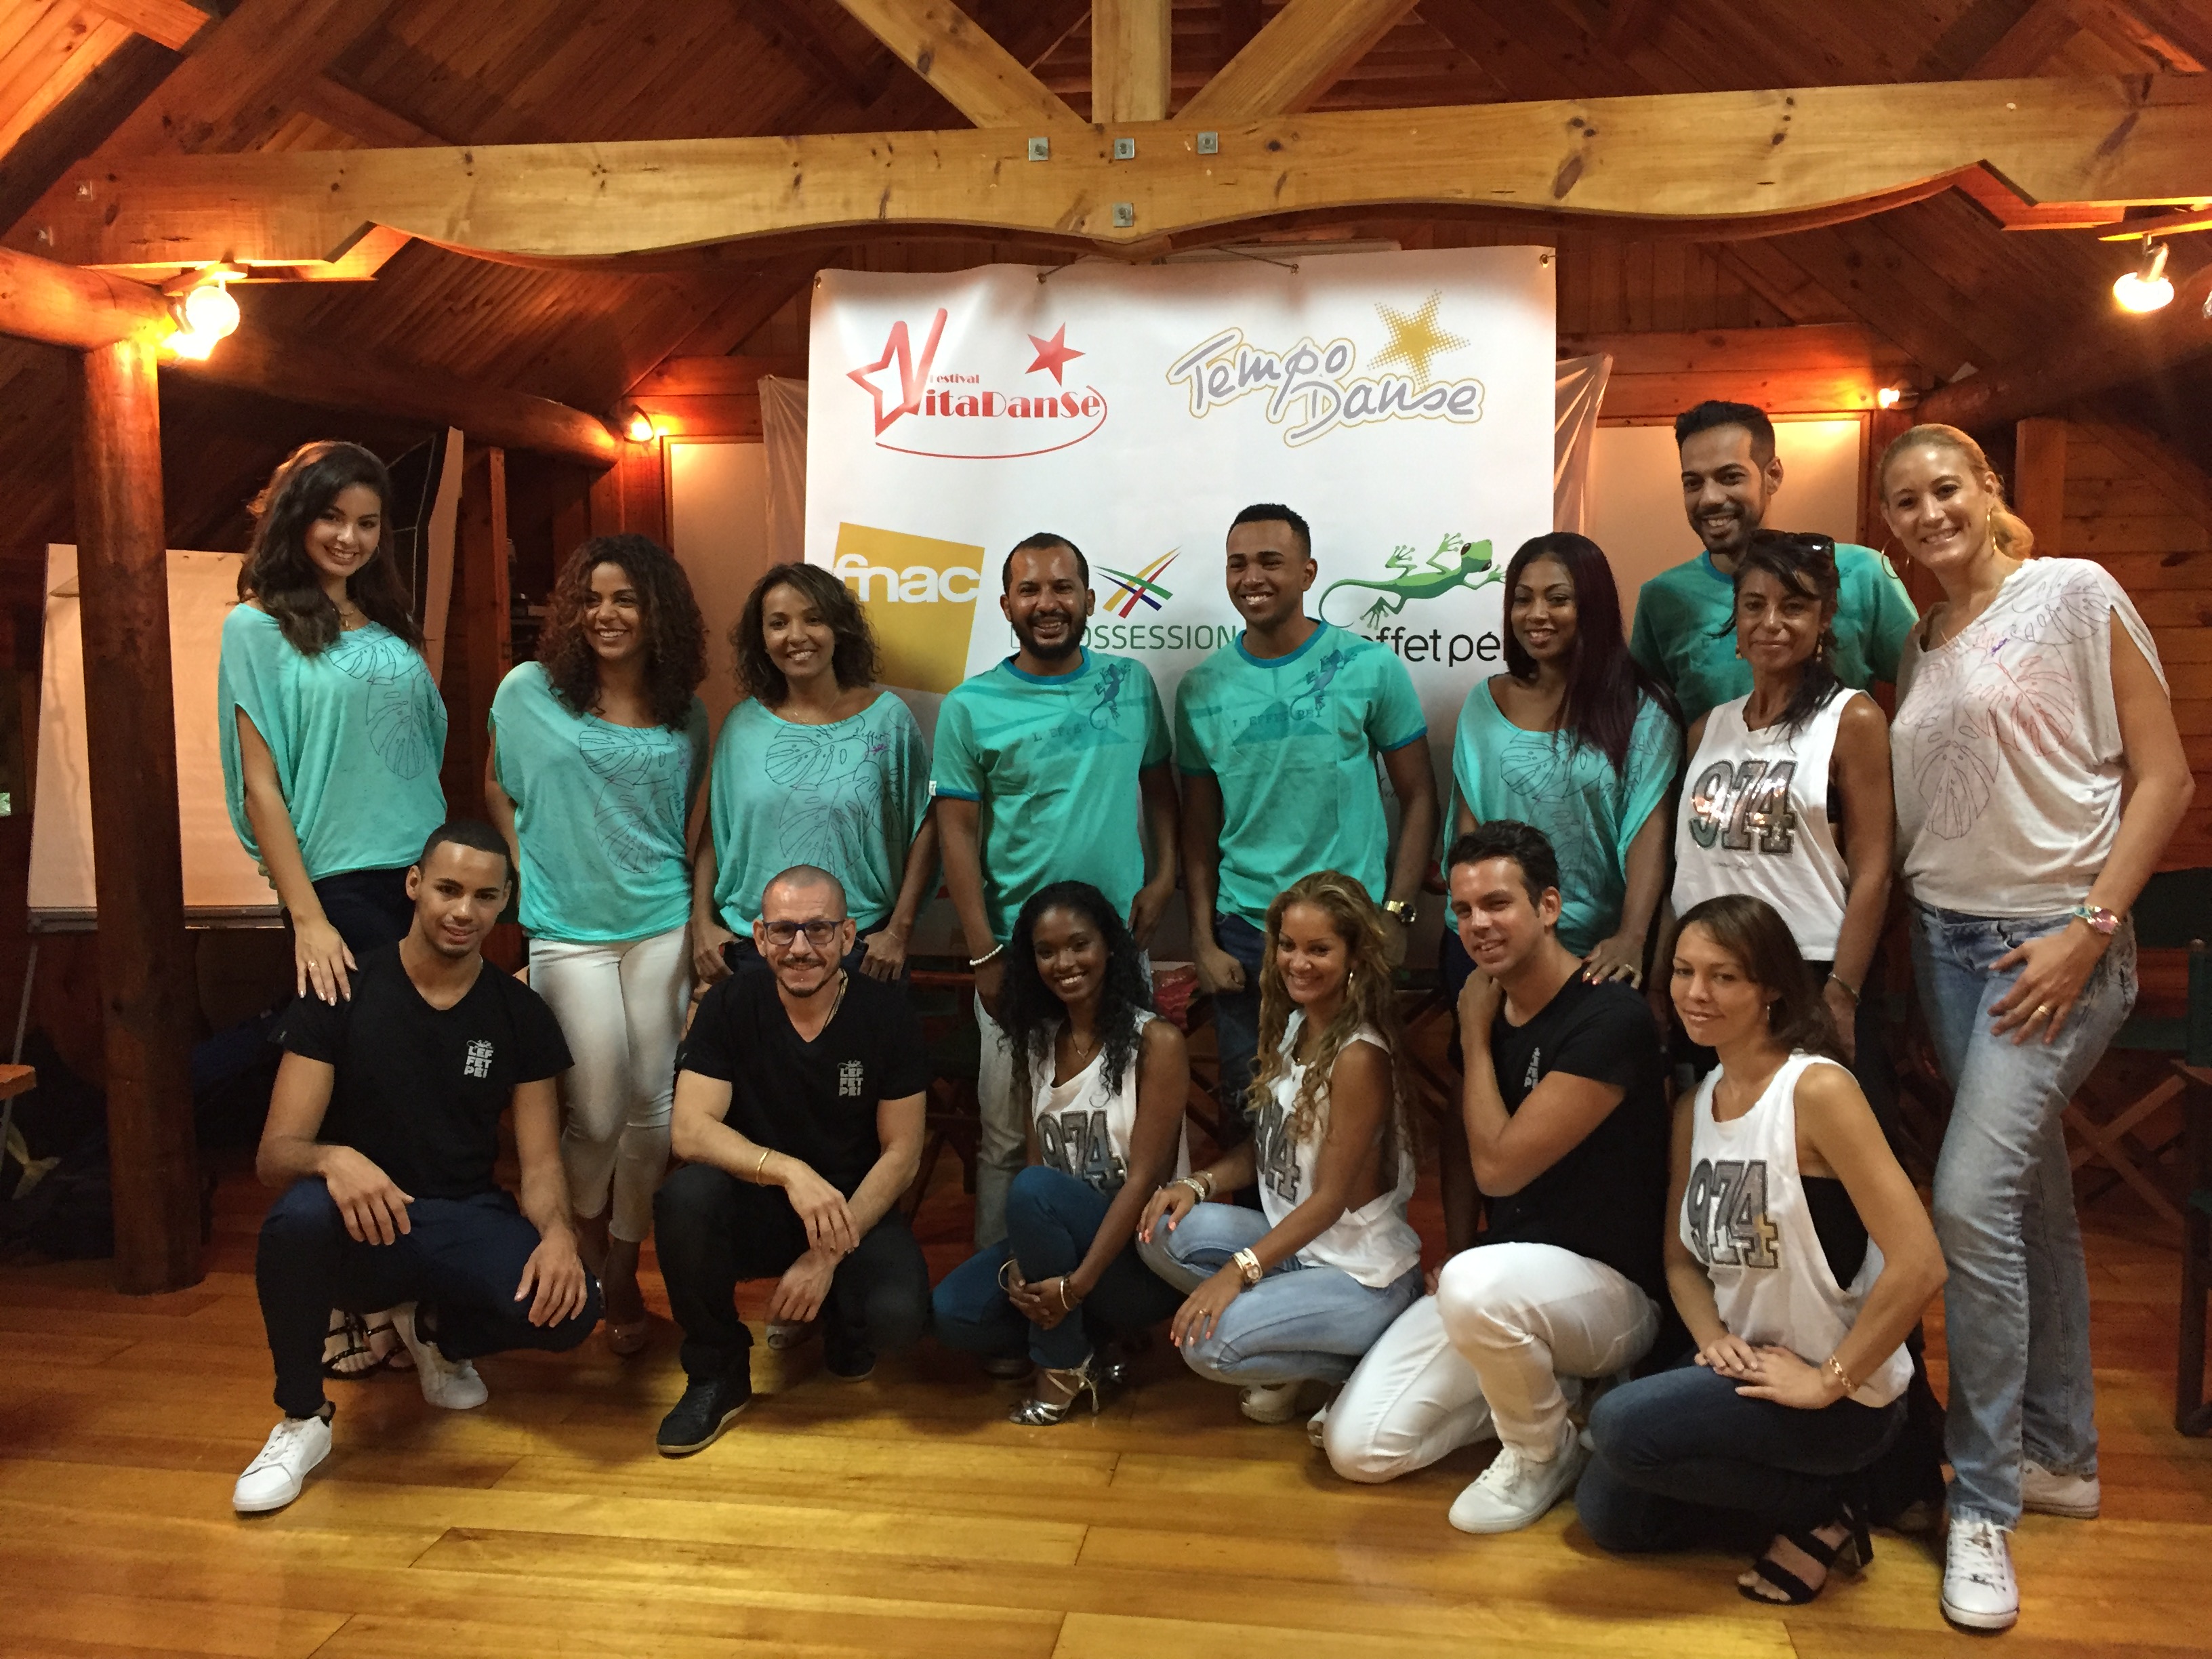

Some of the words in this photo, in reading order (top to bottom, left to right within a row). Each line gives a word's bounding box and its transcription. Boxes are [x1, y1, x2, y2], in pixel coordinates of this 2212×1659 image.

[1174, 334, 1348, 415] Tempo
[1290, 380, 1477, 440] Danse
[834, 553, 981, 603] fnac
[1359, 626, 1441, 662] ffet
[1689, 760, 1797, 853] 974
[1036, 1110, 1126, 1191] 974
[1687, 1158, 1779, 1269] 974
